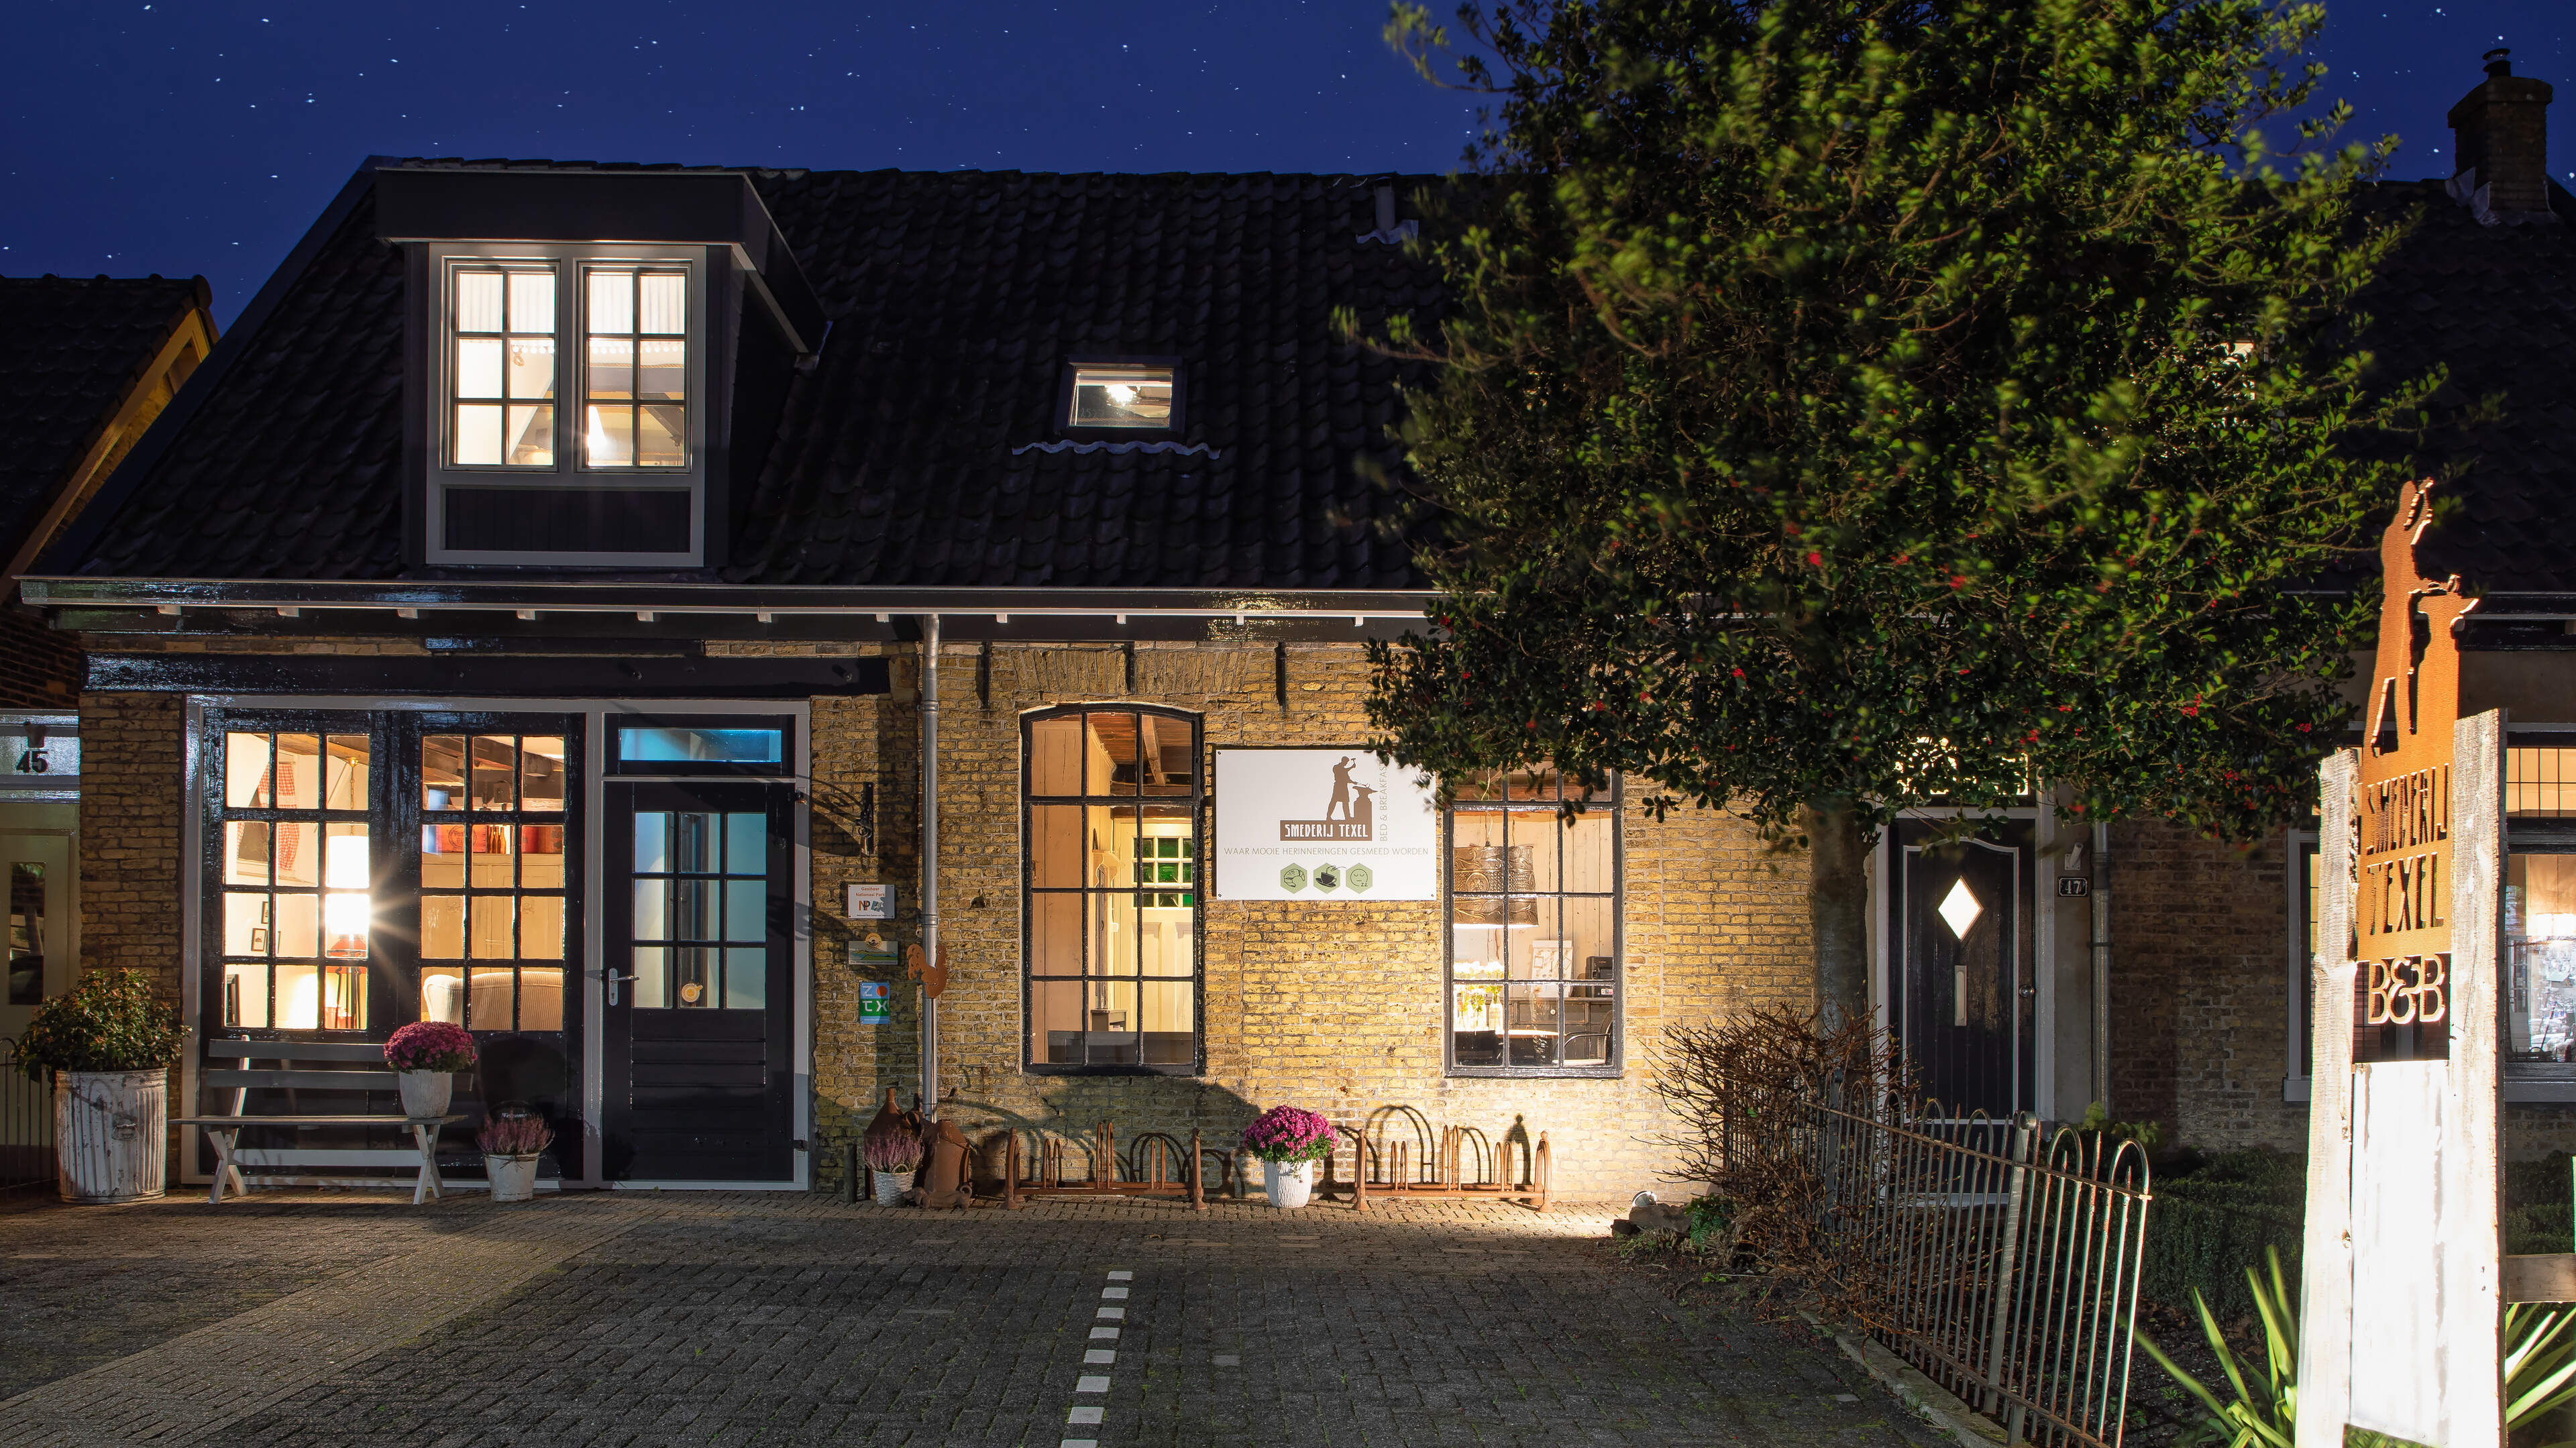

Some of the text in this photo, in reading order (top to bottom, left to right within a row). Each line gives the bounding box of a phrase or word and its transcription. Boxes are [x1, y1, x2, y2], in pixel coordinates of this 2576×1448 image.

[15, 750, 49, 773] 45
[2365, 763, 2449, 856] SMEDERIJ
[1284, 824, 1368, 838] SMEDERIJ TEXEL
[1379, 824, 1388, 842] BED
[1224, 846, 1428, 856] WAAR MOOIE HERINNERINGEN GESMEED WORDEN
[2366, 851, 2445, 936] TEXEL
[858, 900, 871, 911] NP
[2367, 954, 2447, 1025] B&B
